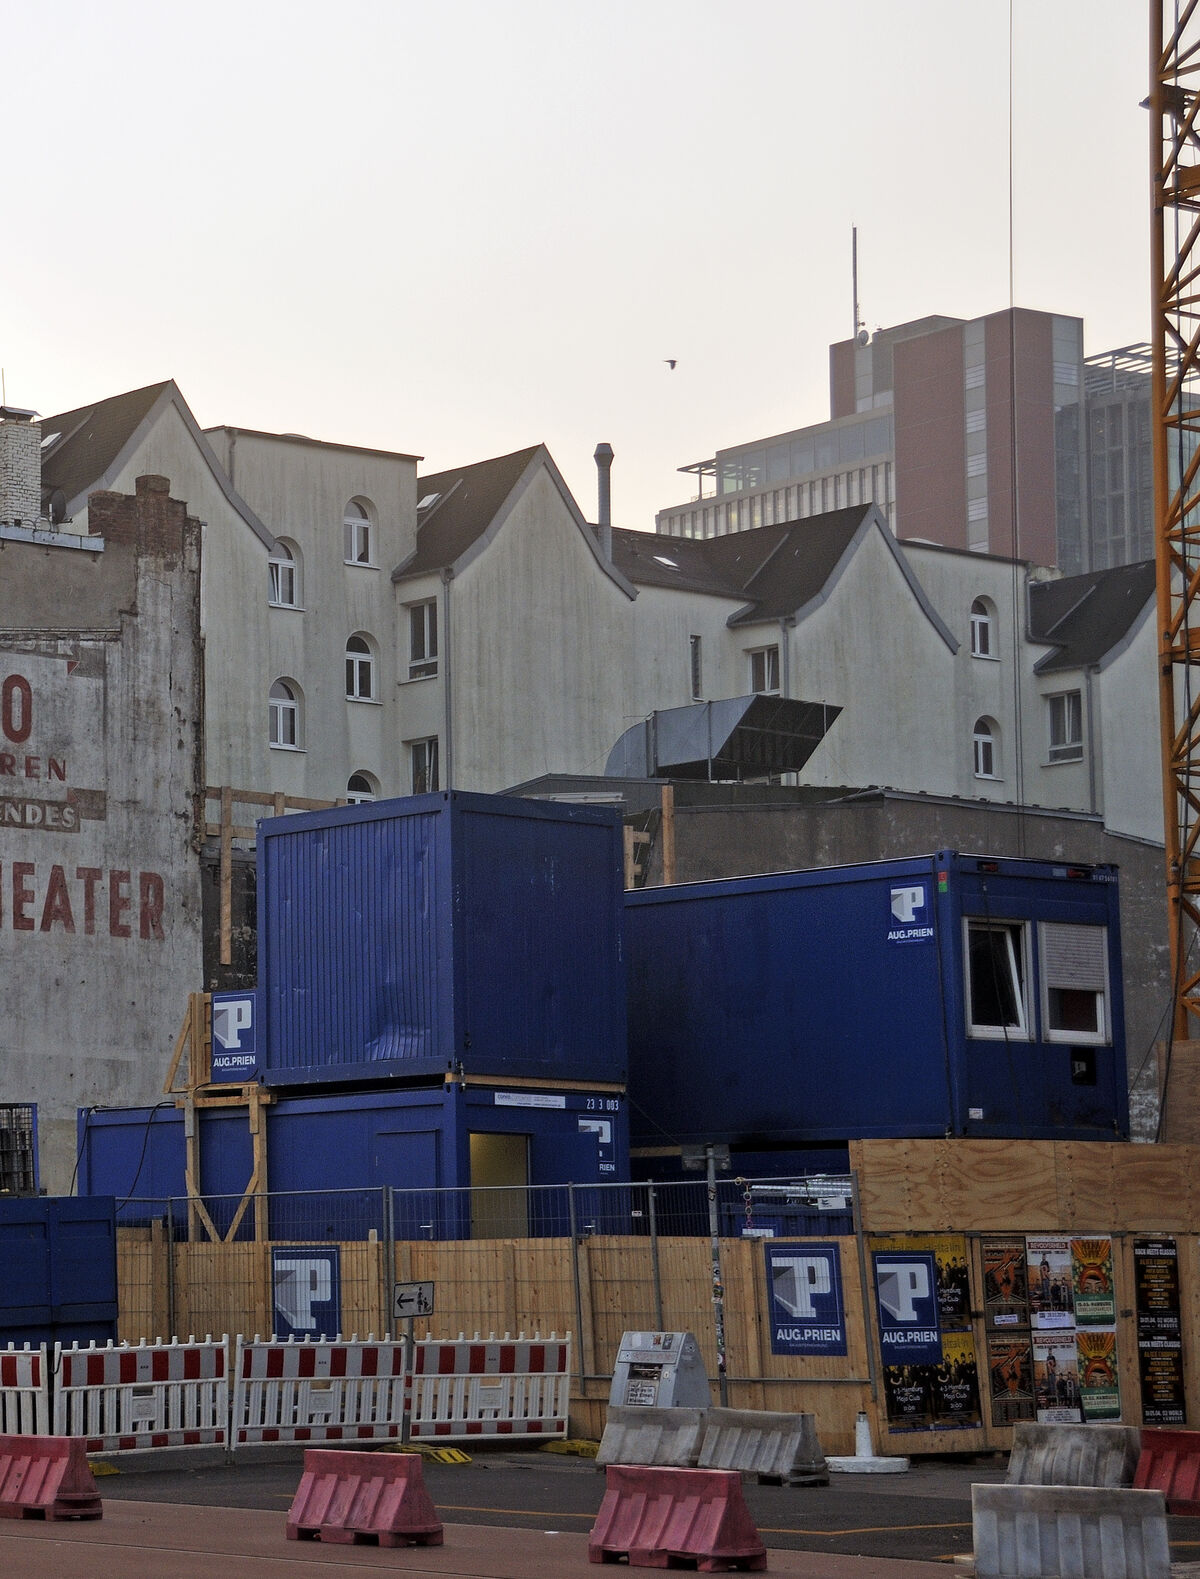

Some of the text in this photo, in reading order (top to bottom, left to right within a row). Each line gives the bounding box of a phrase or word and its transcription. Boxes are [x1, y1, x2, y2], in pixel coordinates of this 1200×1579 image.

[887, 926, 934, 942] AUG.PRIEN
[213, 1055, 256, 1068] AUG.PRIEN
[776, 1328, 841, 1342] AUG.PRIEN
[882, 1330, 939, 1343] AUG.PRIEN
